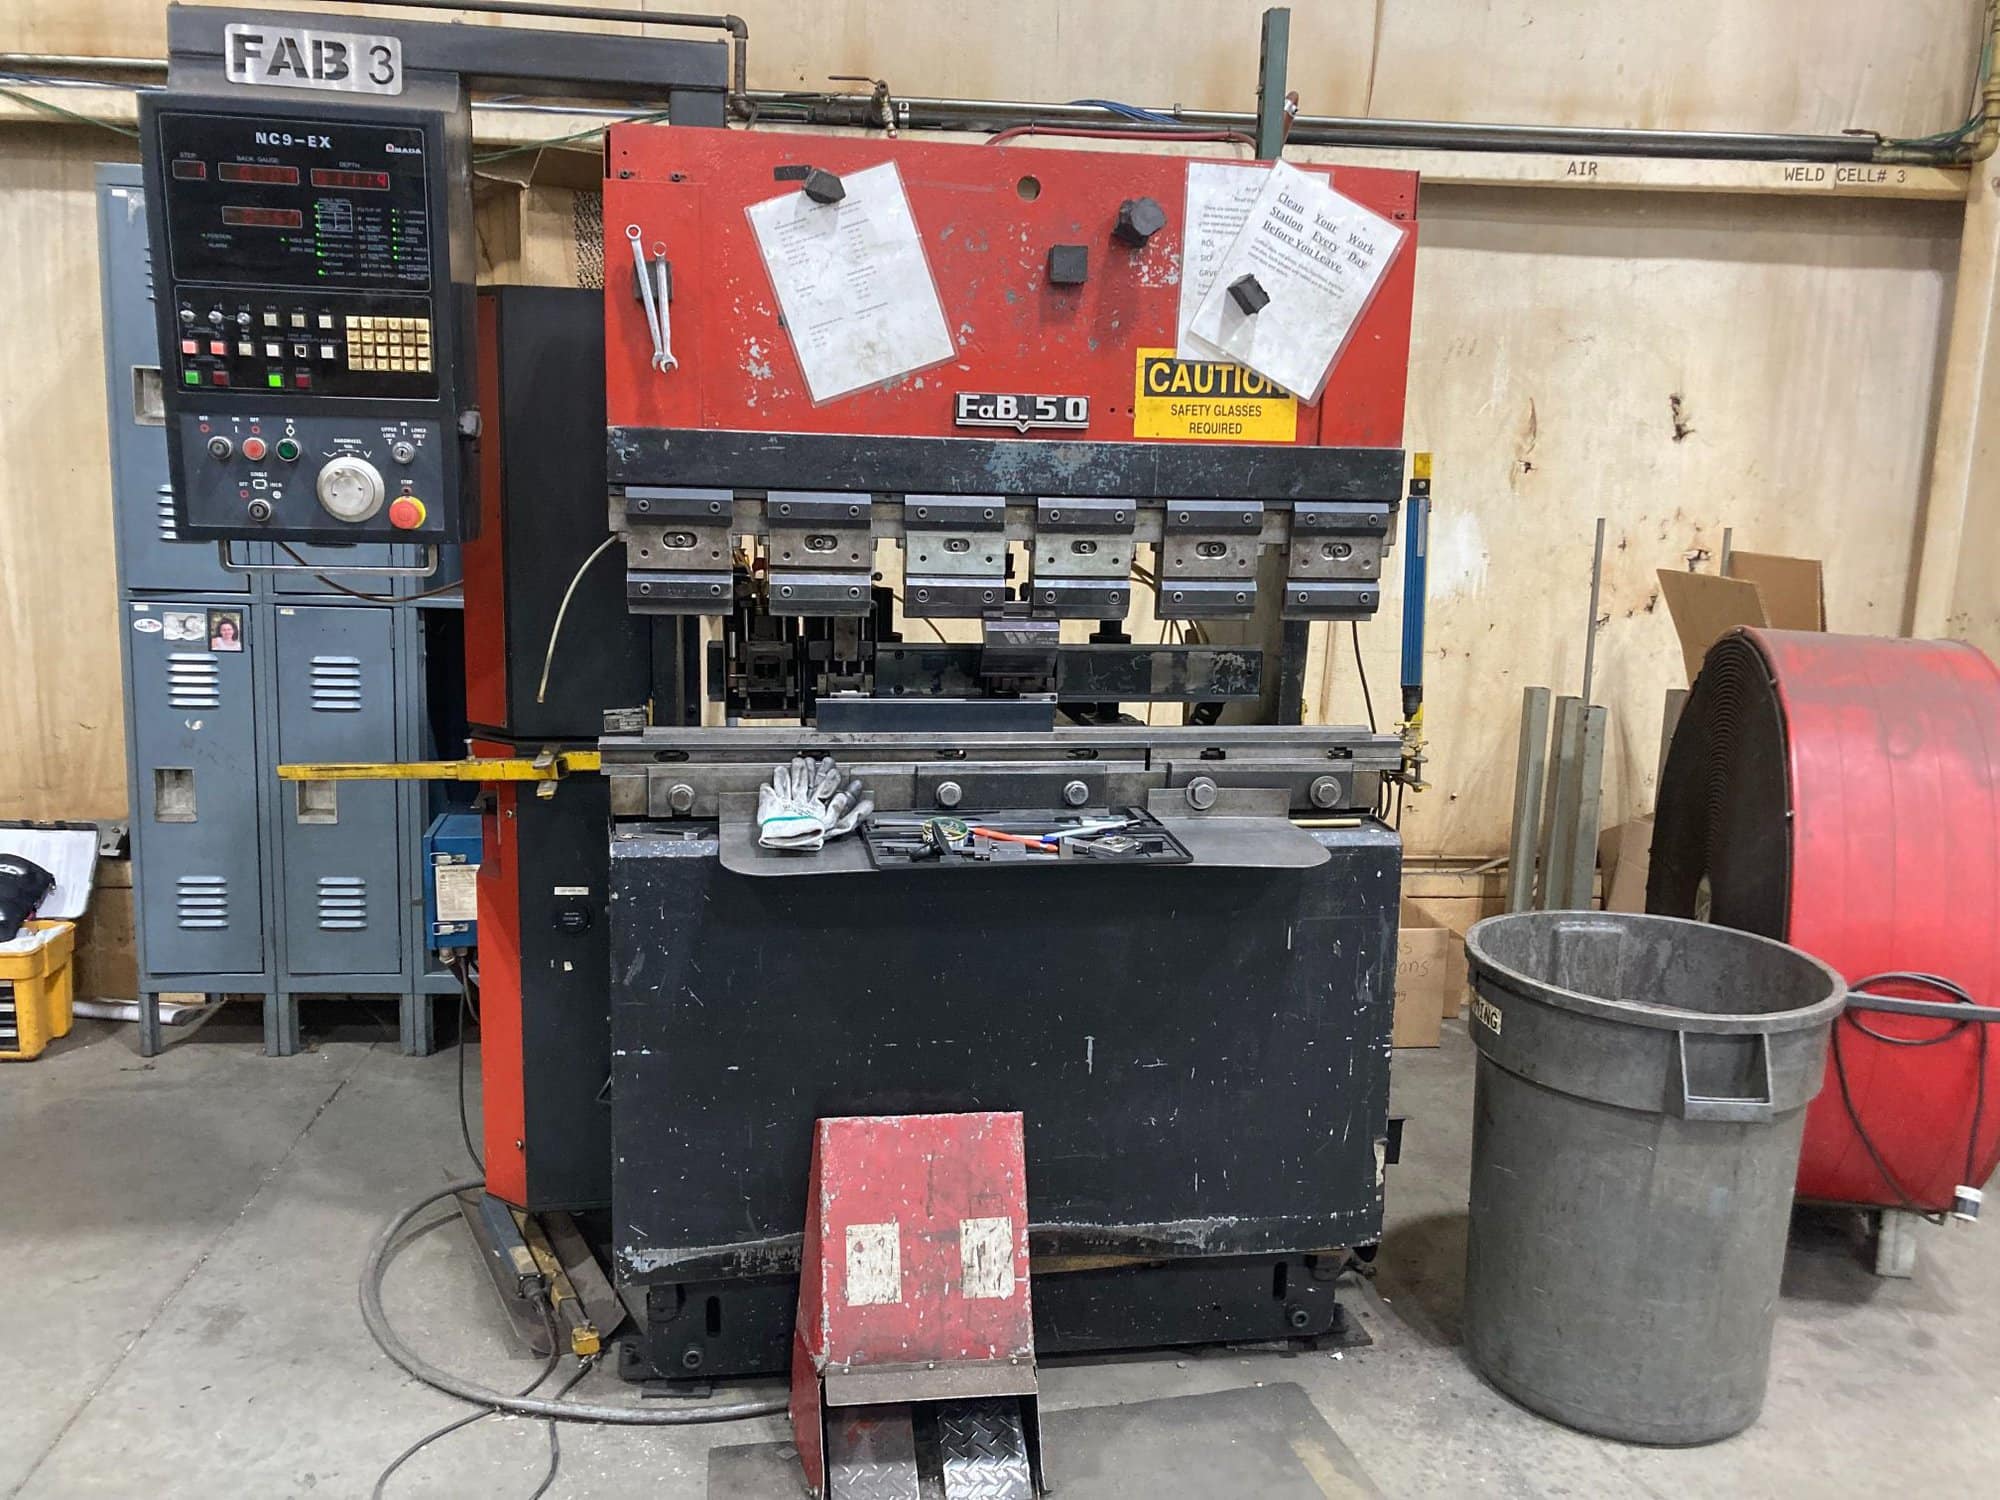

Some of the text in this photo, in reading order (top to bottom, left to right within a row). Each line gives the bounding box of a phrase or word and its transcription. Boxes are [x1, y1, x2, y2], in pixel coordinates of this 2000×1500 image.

[232, 33, 394, 85] FAB 3
[255, 131, 332, 149] NC9-EX
[1567, 161, 1598, 176] AIR
[1784, 167, 1905, 184] WELD CELL# 3
[1278, 192, 1376, 256] Clean Your Work
[1262, 220, 1295, 245] Before
[1295, 238, 1314, 257] You
[1269, 206, 1368, 270] Station Every Day
[1170, 404, 1262, 418] SAFETY GLASSES
[1189, 422, 1242, 435] REQUIRED
